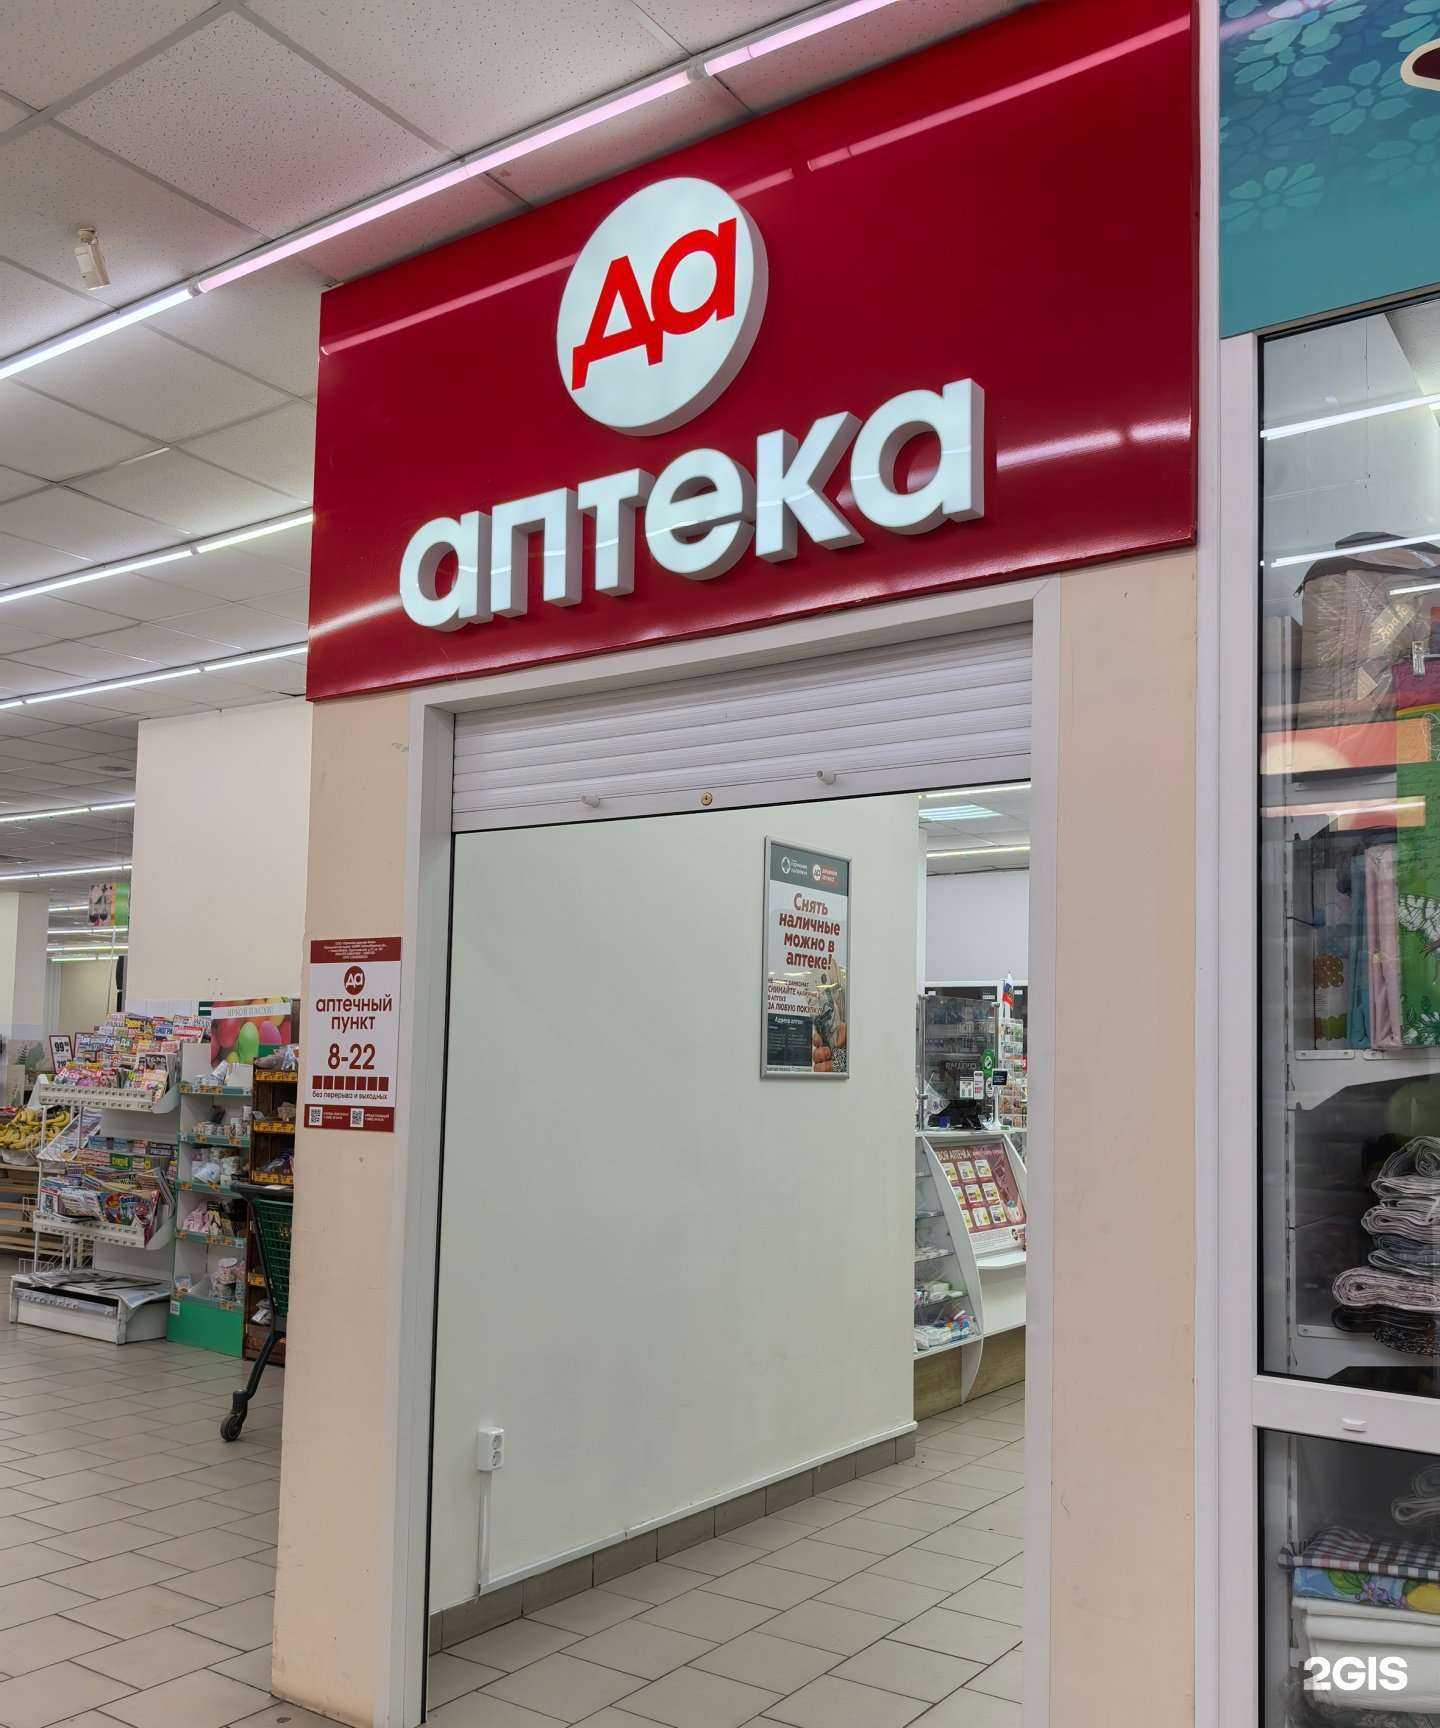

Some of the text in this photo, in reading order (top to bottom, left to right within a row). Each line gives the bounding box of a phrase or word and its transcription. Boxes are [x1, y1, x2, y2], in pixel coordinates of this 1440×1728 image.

[399, 378, 986, 633] аптека
[793, 892, 829, 915] Снять
[779, 912, 841, 936] наличные
[783, 932, 835, 953] можно в
[786, 951, 832, 970] аптеке!
[316, 994, 392, 1012] аптечный
[331, 1015, 375, 1034] пункт
[54, 1041, 65, 1053] 99
[327, 1042, 376, 1070] 8-22
